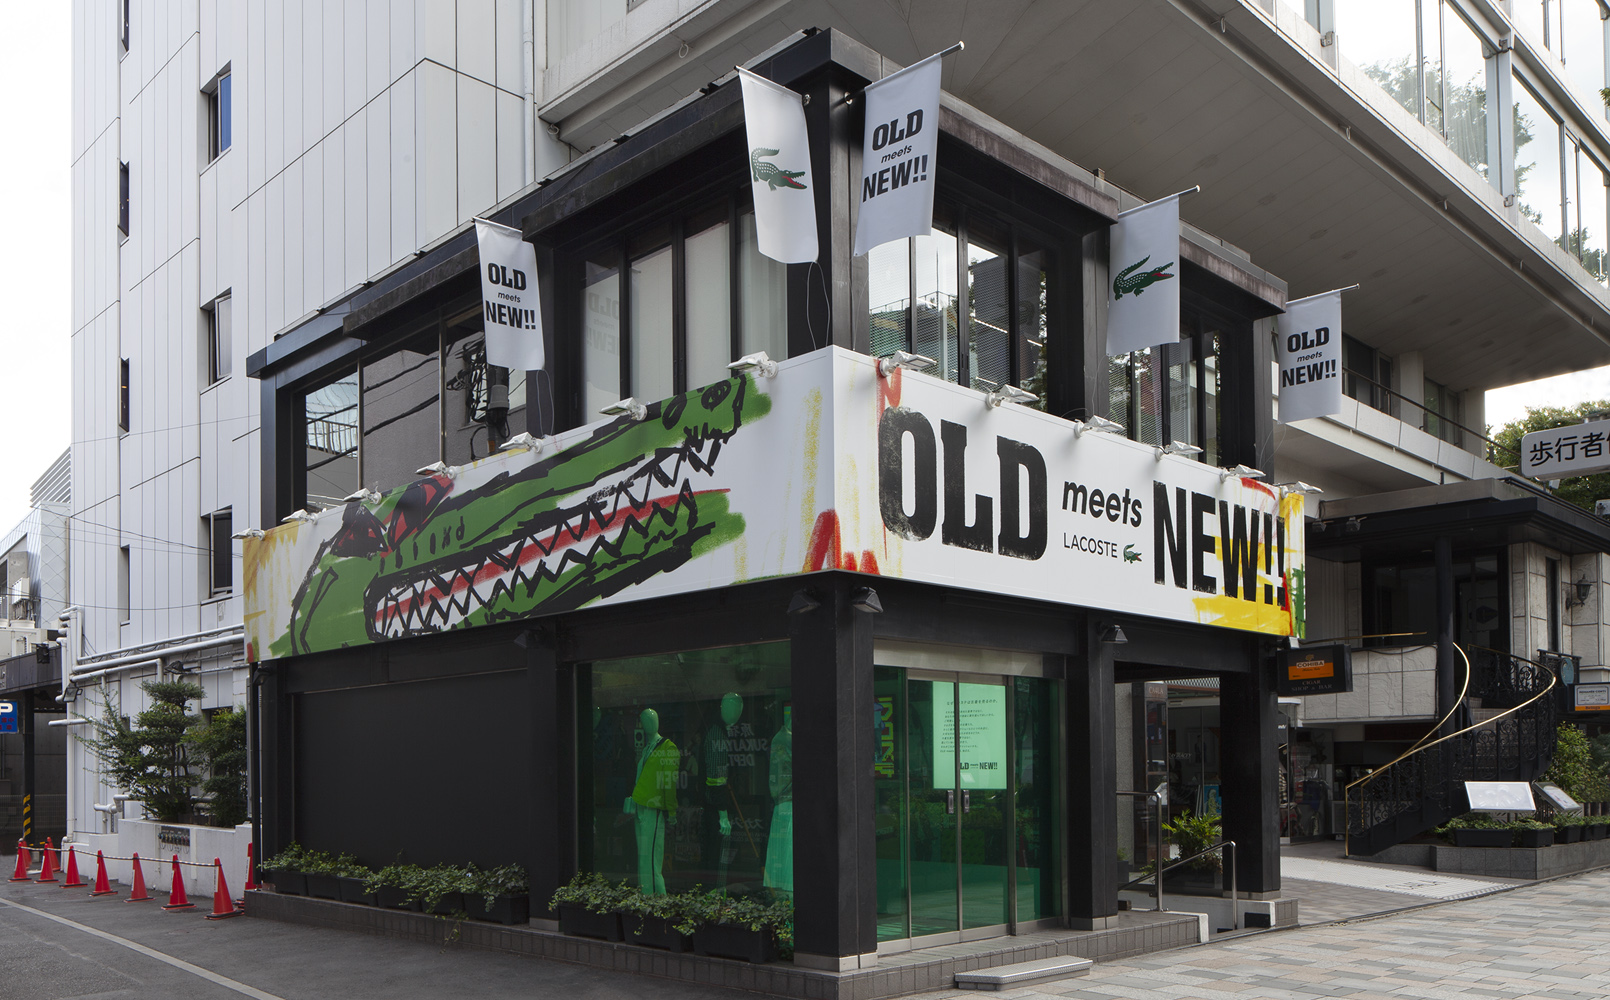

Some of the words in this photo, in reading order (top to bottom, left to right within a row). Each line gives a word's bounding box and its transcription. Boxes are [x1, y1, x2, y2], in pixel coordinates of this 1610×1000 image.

[872, 108, 924, 151] OLD
[880, 145, 912, 163] meets
[862, 154, 928, 203] NEW!!
[487, 262, 527, 291] OLD
[497, 292, 521, 303] meets
[485, 300, 536, 329] NEW!!
[1287, 326, 1330, 353] OLD
[1296, 351, 1322, 362] meets
[1282, 359, 1337, 388] NEW!!
[878, 406, 1048, 561] OLD
[1062, 481, 1142, 528] meets
[1153, 480, 1286, 608] NEW!!
[1063, 532, 1118, 559] LACOSTE
[960, 762, 970, 770] LD
